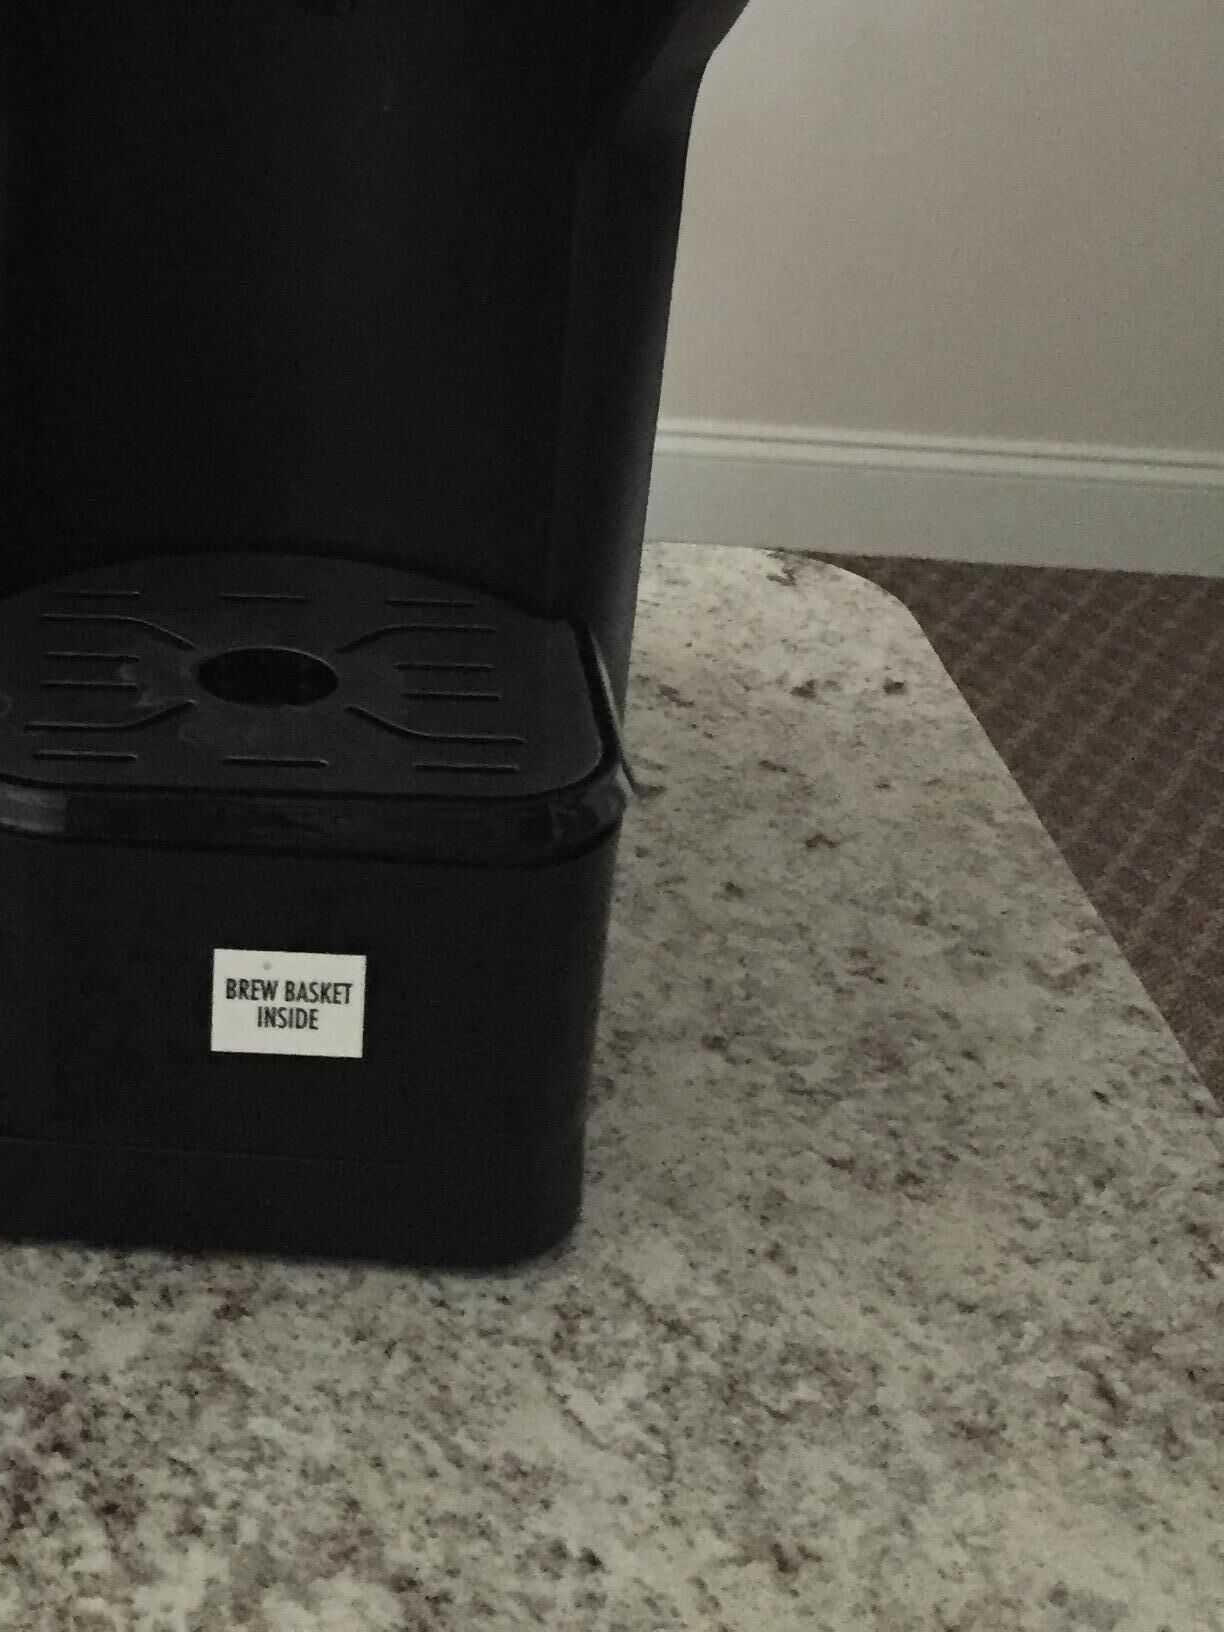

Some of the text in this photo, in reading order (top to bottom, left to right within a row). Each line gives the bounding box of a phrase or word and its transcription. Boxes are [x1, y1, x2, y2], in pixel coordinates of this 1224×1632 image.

[226, 978, 353, 1005] BREW BASKET
[257, 1007, 320, 1030] INSIDE
